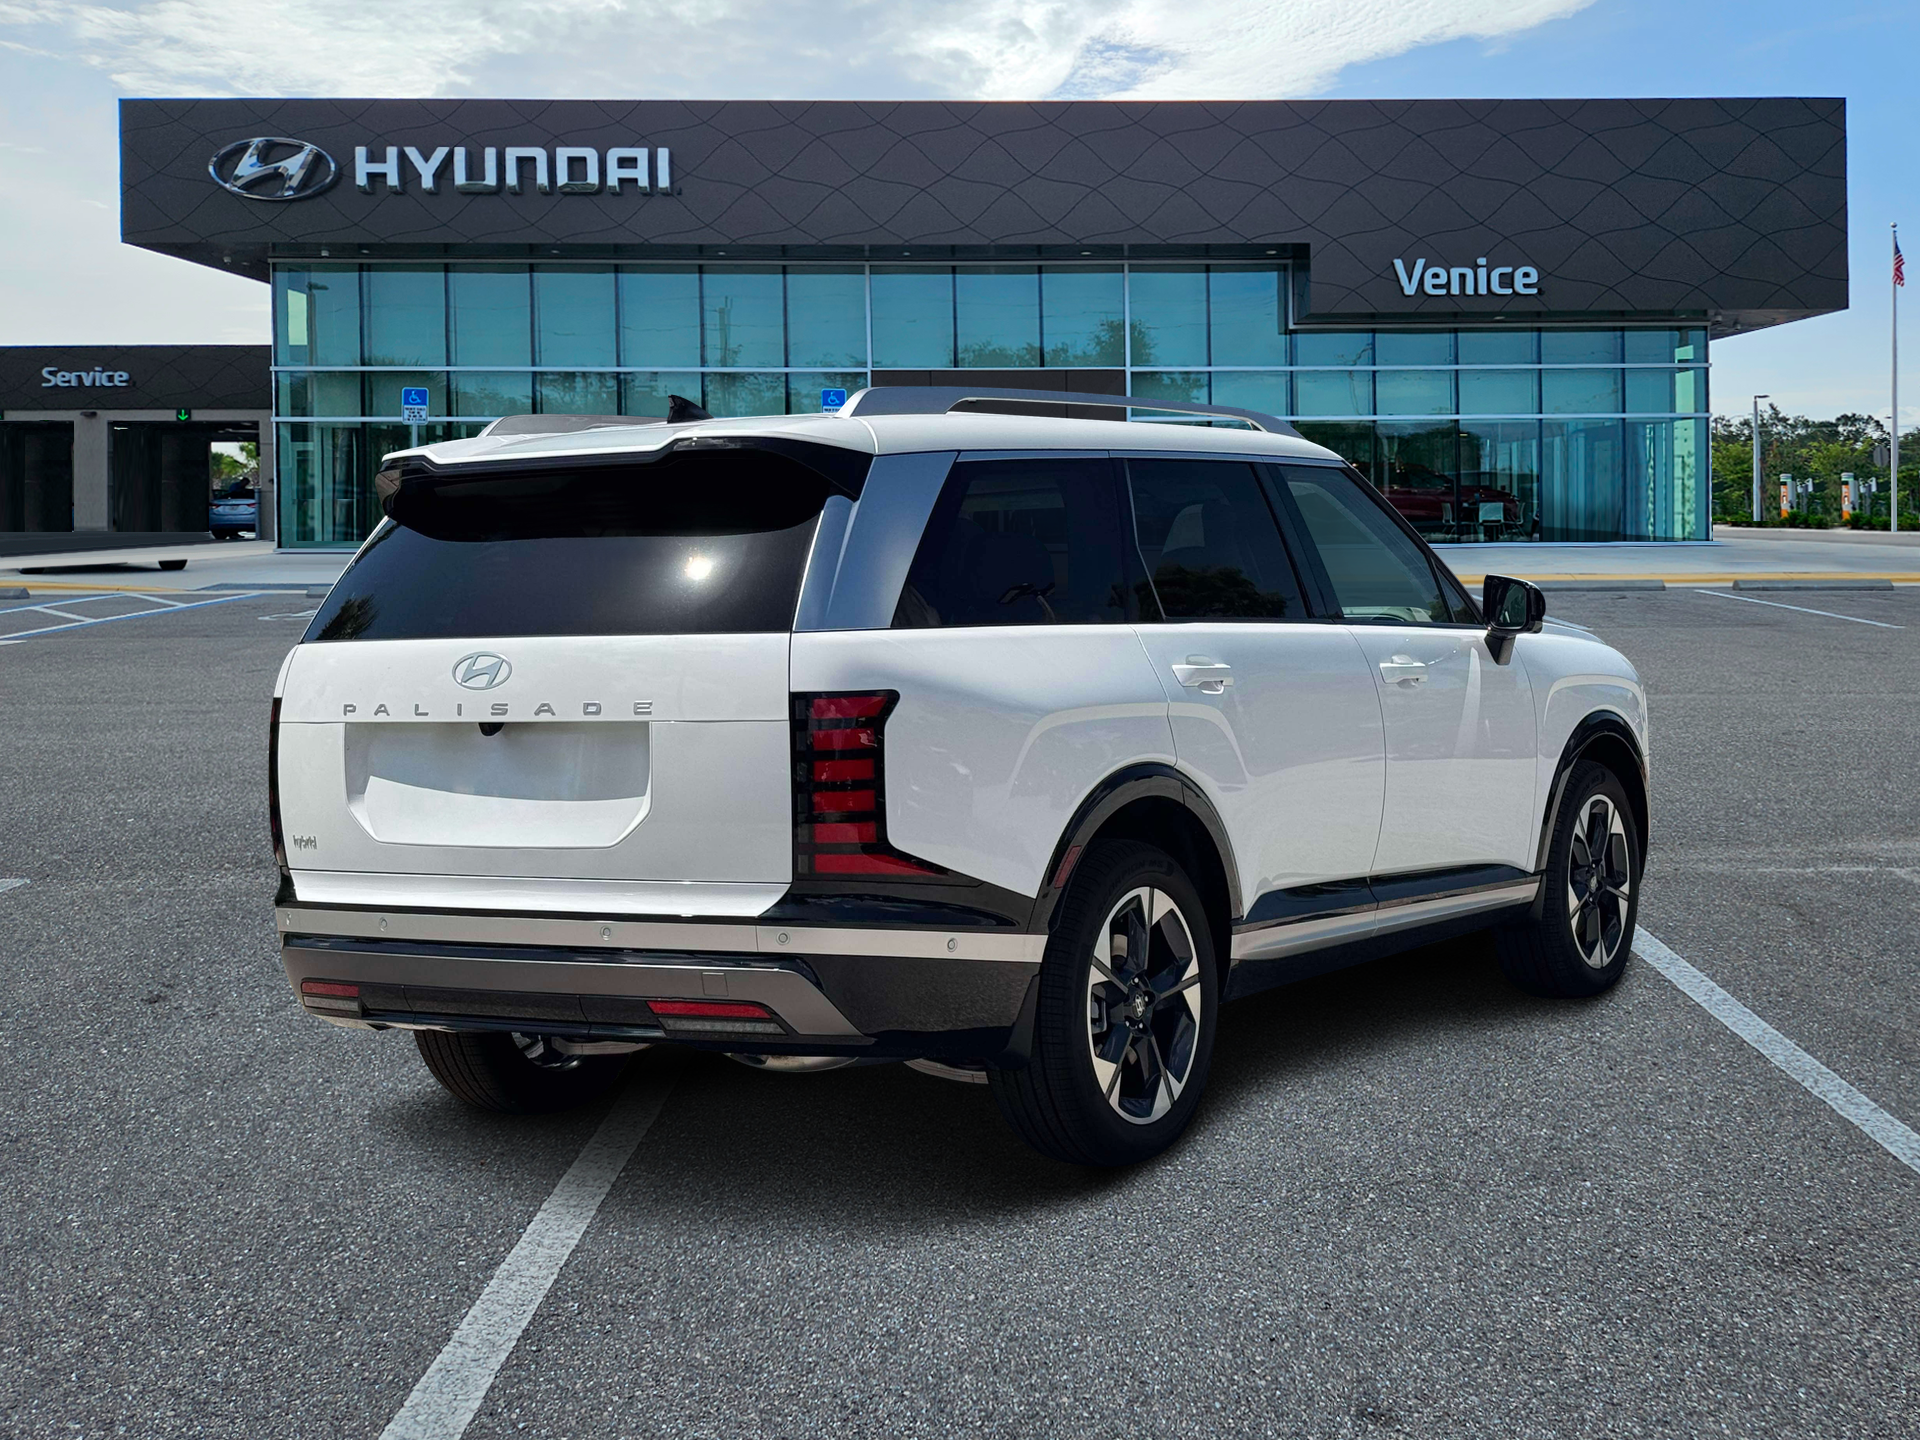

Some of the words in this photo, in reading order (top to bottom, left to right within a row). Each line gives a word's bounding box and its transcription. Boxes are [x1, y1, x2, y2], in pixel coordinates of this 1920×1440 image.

[355, 146, 671, 195] HYUNDAI
[1393, 257, 1539, 296] Venice
[41, 366, 130, 388] Service
[343, 700, 653, 717] PALISADE
